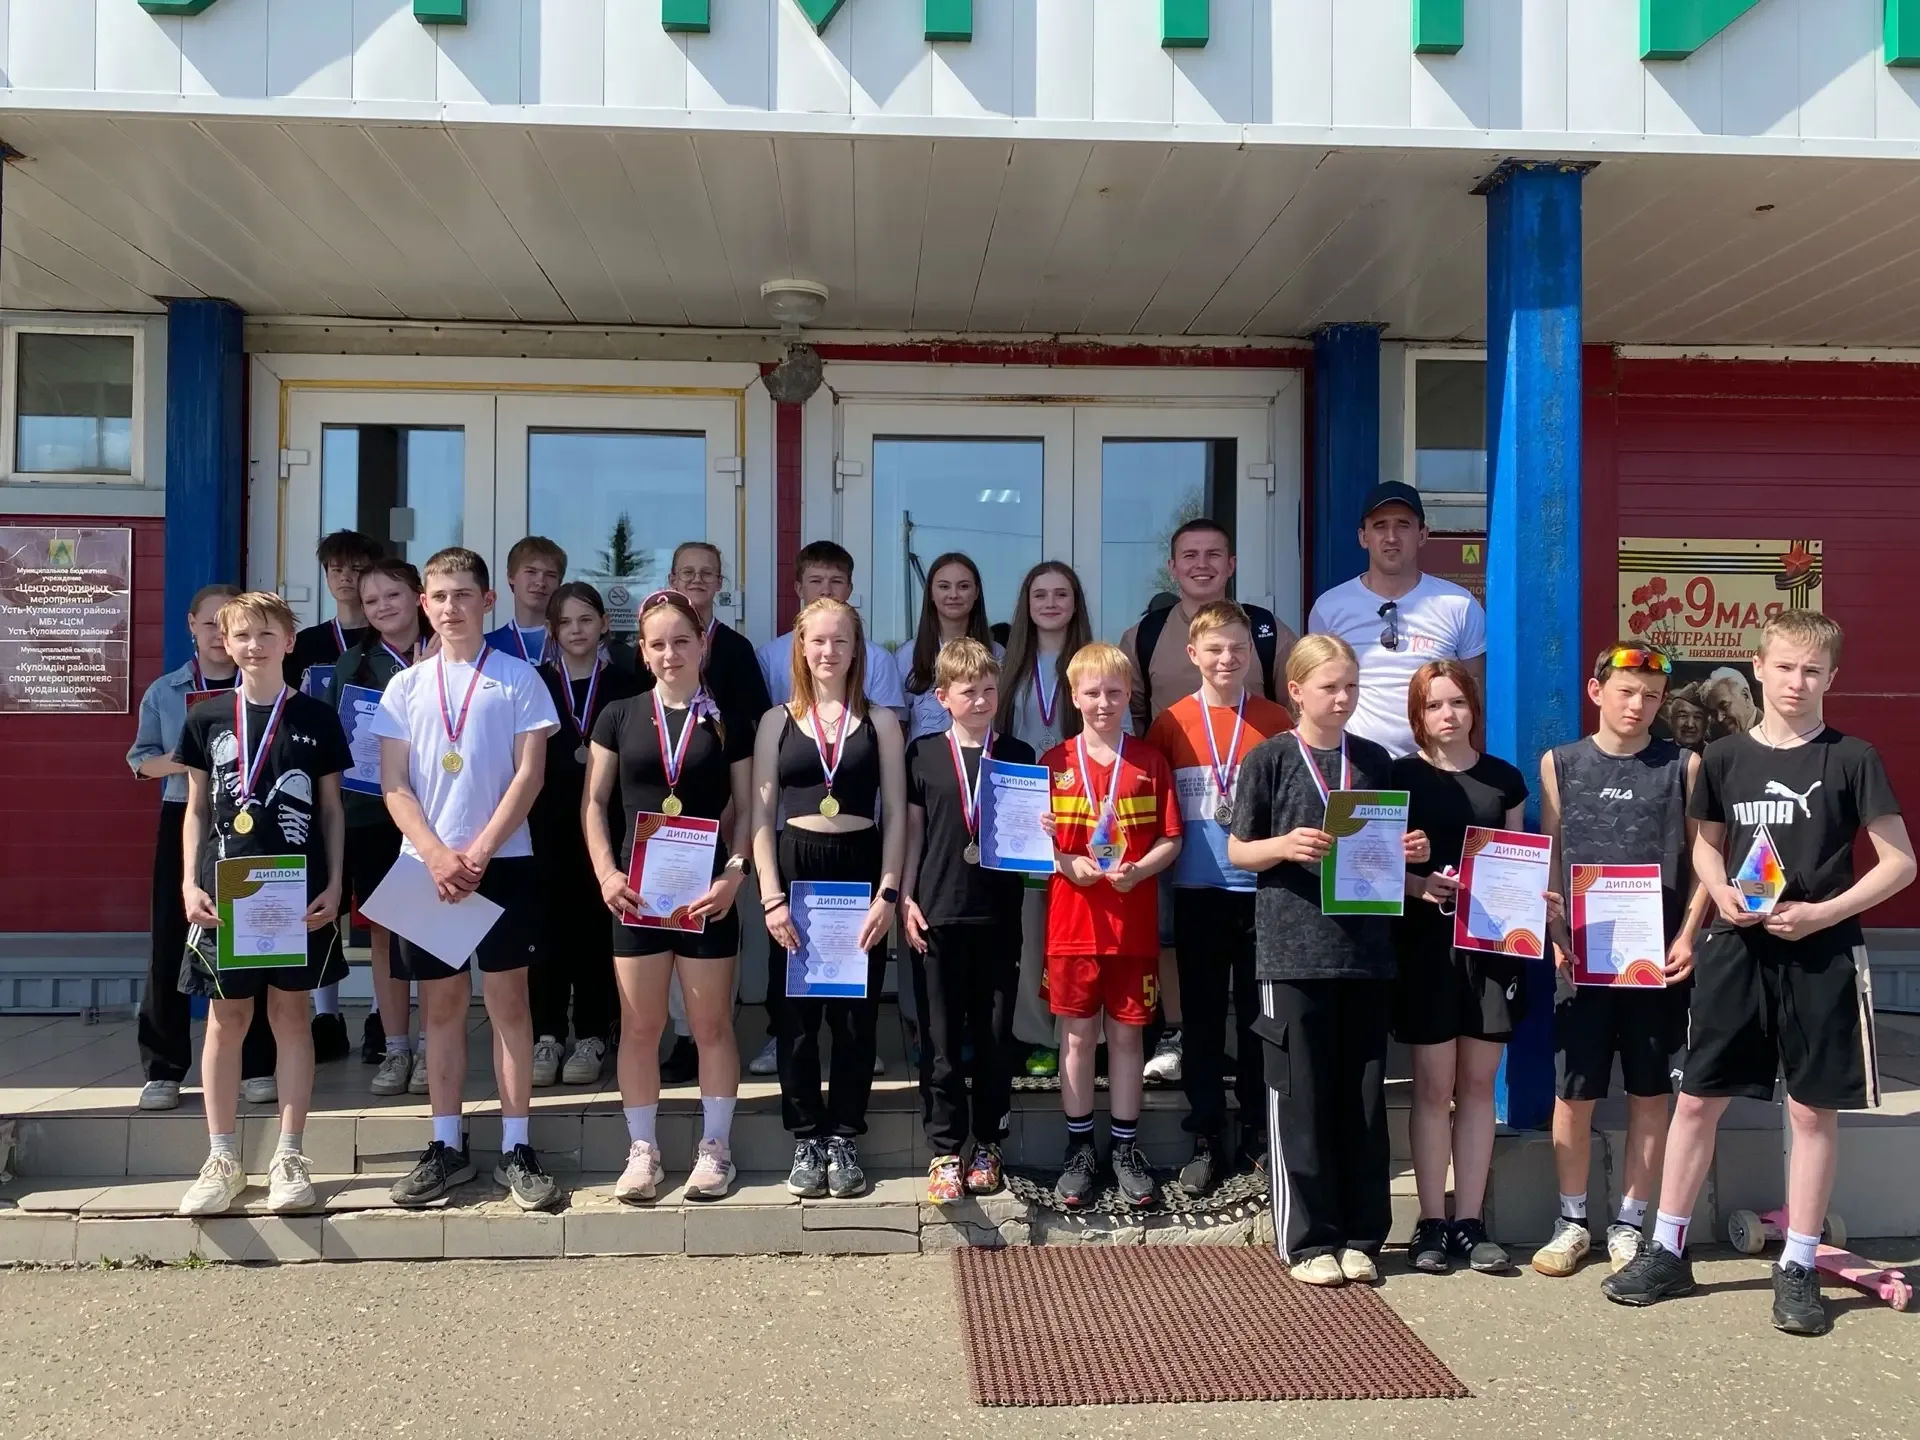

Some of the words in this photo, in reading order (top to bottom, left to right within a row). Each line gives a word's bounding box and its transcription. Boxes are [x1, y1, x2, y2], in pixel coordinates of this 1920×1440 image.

[70, 567, 107, 575] бюджетное
[50, 585, 109, 595] спортивных
[30, 596, 93, 605] мероприятий
[1684, 576, 1715, 628] 9
[1, 605, 81, 615] Усть-Куломского
[84, 606, 121, 616] района»
[39, 618, 57, 626] МБУ
[59, 618, 84, 627] «ЦСМ
[8, 628, 79, 637] Усть-Куломского
[81, 628, 114, 637] района»
[1650, 631, 1742, 647] ВЕТЕРАНЫ
[1688, 648, 1725, 658] НИЗКИЙ
[1726, 649, 1747, 658] ВАМ
[67, 662, 105, 672] районса
[9, 675, 36, 684] спорт
[39, 675, 112, 684] мероприятиеяс
[1000, 776, 1037, 788] ДИПЛОМ
[1600, 788, 1633, 799] FILA
[1359, 806, 1402, 817] ДИПЛОМ
[666, 829, 708, 842] ДИПЛОМ
[1103, 847, 1113, 857] 2
[1494, 845, 1541, 859] ДИПЛОМ
[255, 869, 300, 880] ДИПЛОМ
[1605, 881, 1652, 889] ДИПЛОМ
[1753, 882, 1766, 895] 3
[816, 897, 857, 906] ДИПЛОМ
